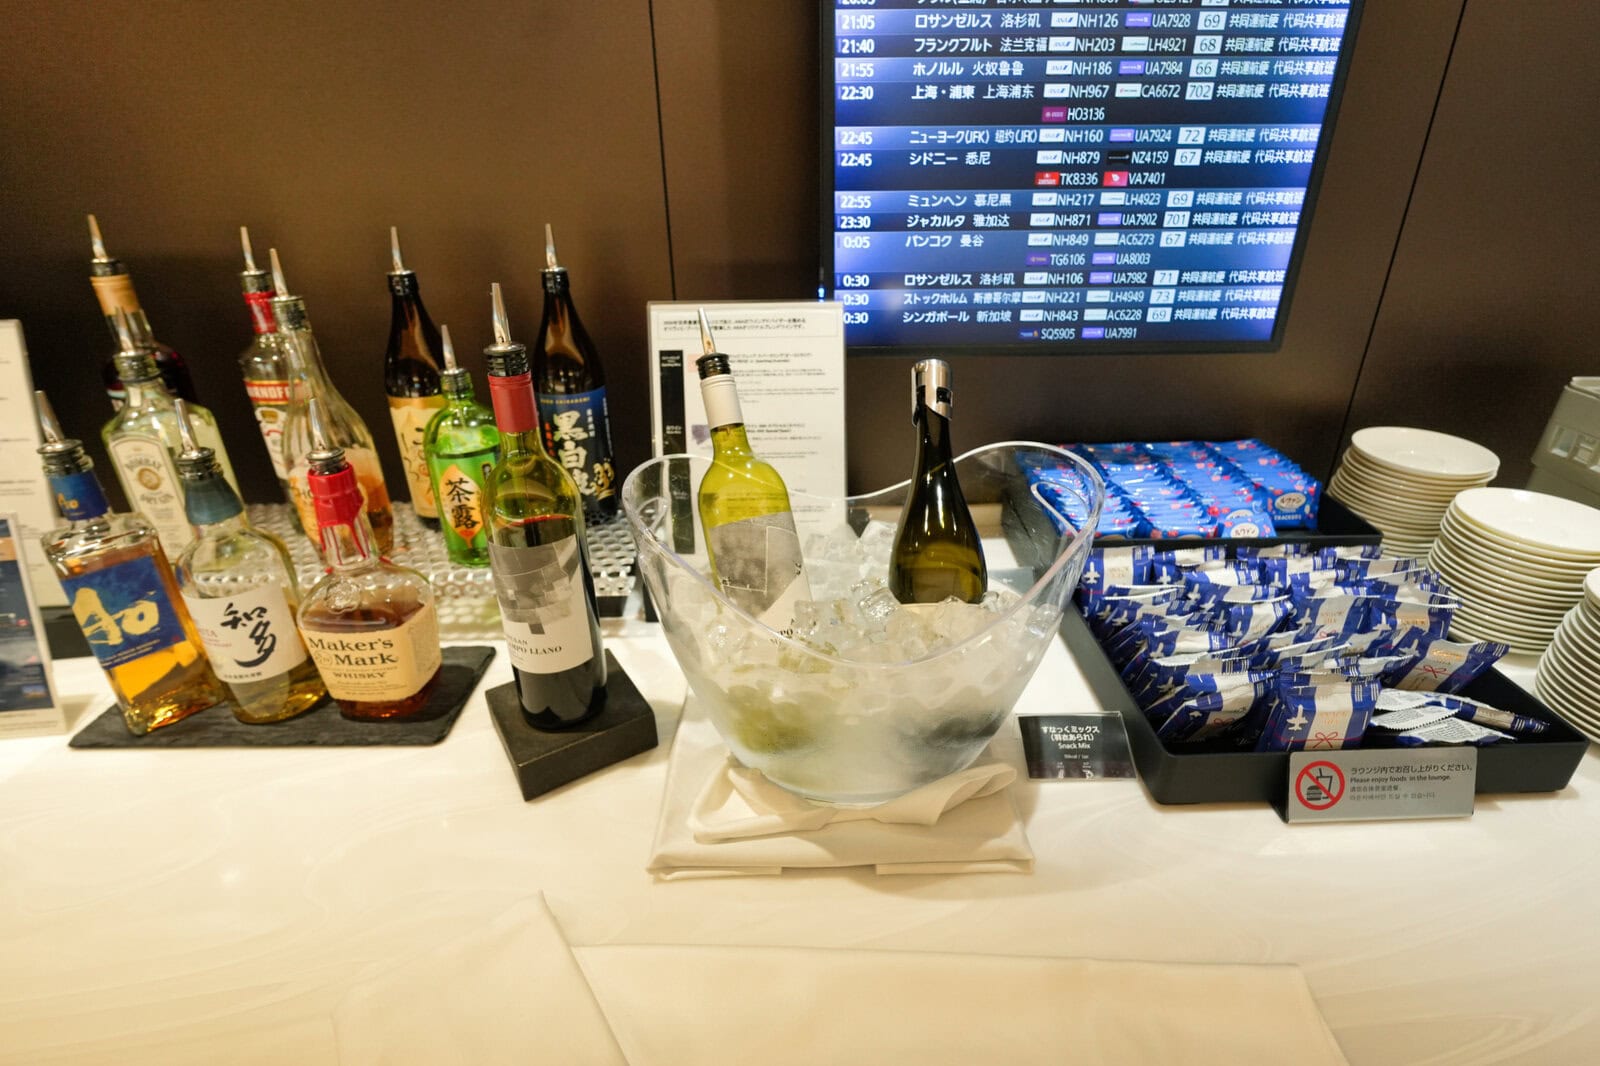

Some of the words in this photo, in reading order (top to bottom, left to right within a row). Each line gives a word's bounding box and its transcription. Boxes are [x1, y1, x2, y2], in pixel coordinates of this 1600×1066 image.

[842, 15, 875, 29] 21:05
[915, 13, 992, 28] ロサンゼルス
[1000, 13, 1041, 28] 洛杉矶
[1078, 14, 1119, 28] NH126
[1152, 14, 1191, 28] UA7928
[1203, 14, 1220, 28] 69
[841, 38, 875, 53] 21:40
[915, 38, 992, 53] フランクフルト
[1000, 37, 1048, 52] 法兰克福
[1075, 37, 1115, 52] NH203
[1148, 38, 1187, 52] LH4921
[1199, 38, 1217, 52] 68
[841, 62, 875, 77] 21:55
[913, 61, 964, 76] ホノルル
[972, 61, 1024, 76] 火奴鲁鲁
[1072, 61, 1112, 75] NH186
[1144, 61, 1183, 75] UA7984
[1195, 61, 1212, 75] 66
[841, 85, 874, 100] 22:30
[911, 85, 975, 99] 上海・浦東
[982, 84, 1034, 99] 上海浦东
[1070, 84, 1109, 98] NH967
[1141, 84, 1181, 98] CA6672
[1189, 84, 1211, 98] 702
[1067, 107, 1105, 121] HO3136
[841, 131, 873, 145] 22:45
[1065, 129, 1104, 142] NH160
[1135, 129, 1172, 142] UA7924
[1184, 130, 1200, 142] 72
[840, 153, 872, 167] 22:45
[909, 152, 958, 165] シドニー
[965, 151, 991, 165] 悉尼
[1062, 151, 1100, 164] NH879
[1131, 151, 1169, 164] NZ4159
[1179, 151, 1196, 164] 67
[1060, 172, 1098, 185] TK8336
[1128, 172, 1166, 185] VA7401
[840, 195, 871, 209] 22:55
[908, 194, 967, 207] ミュンヘン
[1057, 193, 1095, 206] NH217
[1124, 193, 1161, 205] LH4923
[1172, 193, 1188, 205] 69
[840, 216, 871, 229] 23:30
[907, 214, 965, 228] ジャカルタ
[973, 213, 1010, 227] 雅加达
[1055, 213, 1091, 226] NH871
[1122, 213, 1158, 226] UA7902
[1166, 213, 1186, 226] 701
[843, 235, 871, 249] 0:05
[960, 234, 984, 247] 曼谷
[1053, 233, 1089, 246] NH849
[1118, 233, 1155, 246] AC6273
[1165, 233, 1181, 245] 67
[1050, 253, 1086, 265] TG6106
[1116, 253, 1151, 265] UA8003
[842, 274, 870, 287] 0:30
[904, 273, 973, 286] ロサンゼルス
[979, 273, 1015, 285] 洛杉矶
[1048, 272, 1084, 284] NH106
[1113, 272, 1148, 284] UA7982
[1158, 271, 1174, 283] 71
[842, 292, 869, 305] 0:30
[903, 292, 968, 305] ストックホルム
[1046, 291, 1081, 303] NH221
[1110, 290, 1144, 302] LH4949
[1155, 290, 1171, 302] 73
[903, 311, 970, 323] シンガポール
[976, 309, 1012, 322] 新加坡
[1043, 309, 1078, 322] NH843
[1107, 309, 1142, 321] AC6228
[1152, 308, 1167, 320] 69
[1041, 327, 1076, 340] SQ5905
[1104, 327, 1138, 339] UA7991
[445, 477, 481, 529] 茶露
[308, 637, 394, 651] Maker's
[529, 646, 562, 655] LLANO
[334, 653, 398, 666] Mark
[332, 671, 387, 679] WHISKY
[1040, 725, 1100, 734] すなっくミックス
[1351, 763, 1473, 775] ラウンジ内でお召し上がりください。
[1371, 776, 1388, 784] enjoy
[1428, 774, 1451, 782] lounge.
